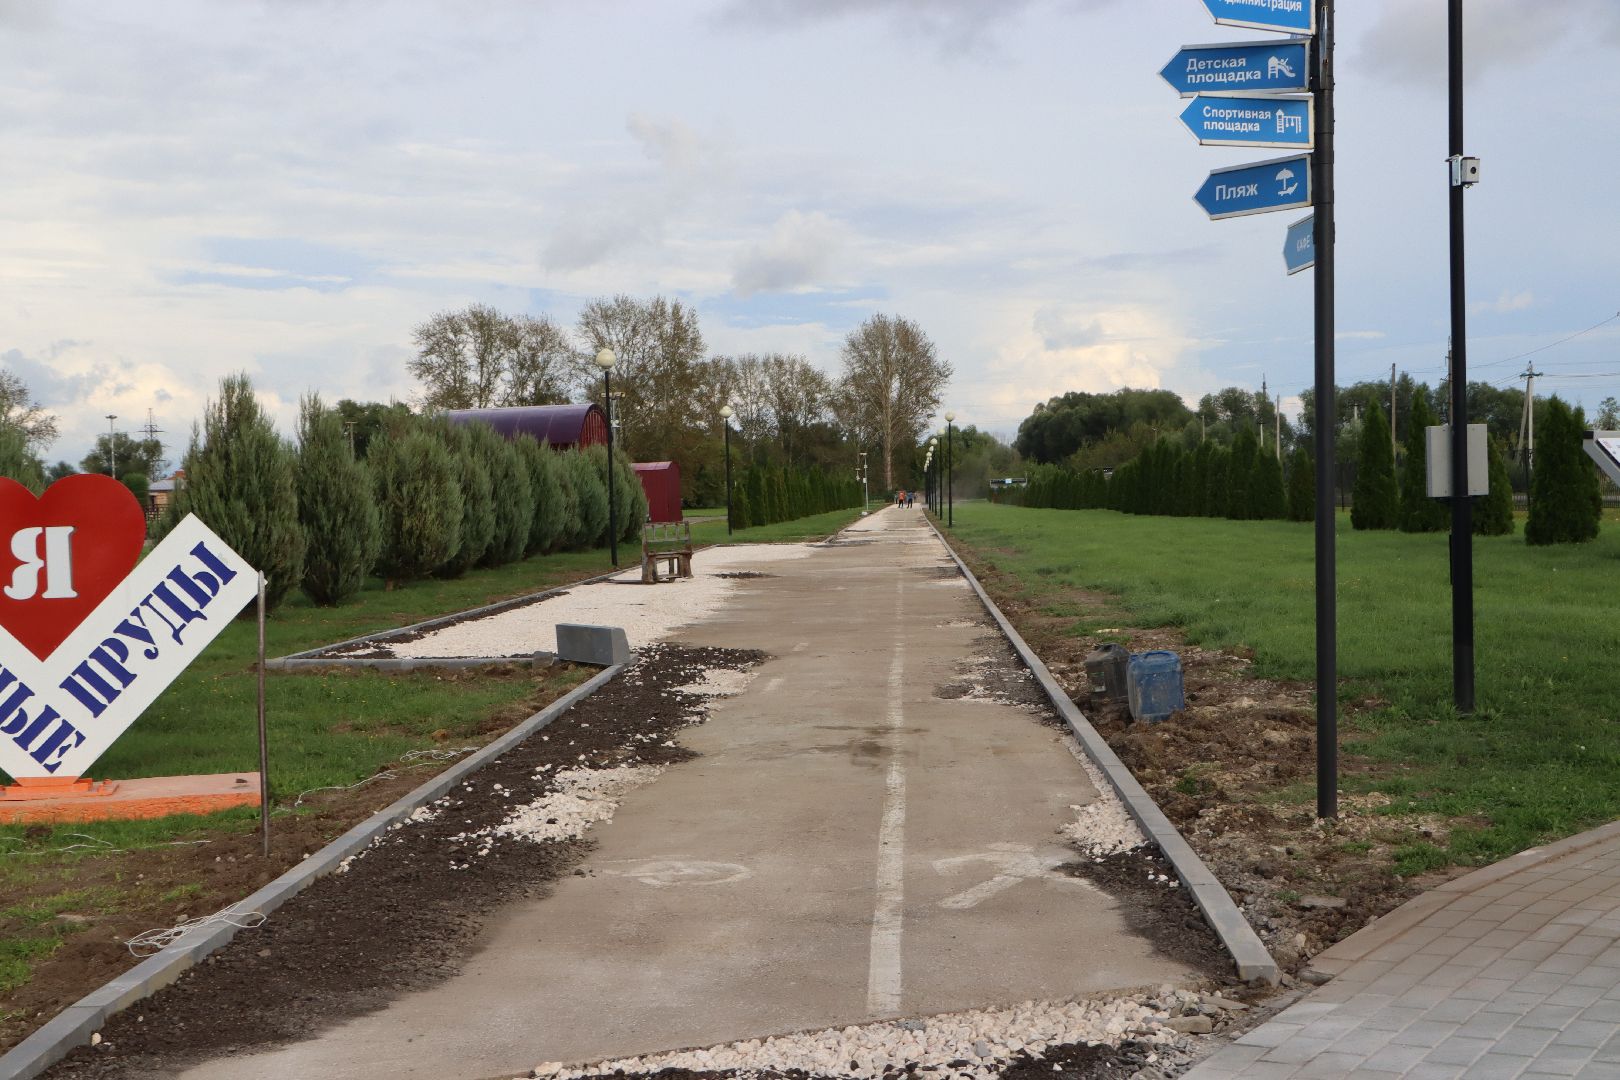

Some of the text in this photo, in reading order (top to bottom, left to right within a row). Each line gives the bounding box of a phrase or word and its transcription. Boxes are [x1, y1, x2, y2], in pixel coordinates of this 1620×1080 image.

[1219, 0, 1302, 12] нистрация
[1187, 57, 1246, 72] Детская
[1187, 70, 1262, 84] площадка
[1203, 106, 1271, 120] Спортивная
[1203, 120, 1260, 132] площадка
[1215, 184, 1258, 201] Пляж
[3, 526, 78, 600] Я
[59, 541, 238, 719] ПРУДЫ
